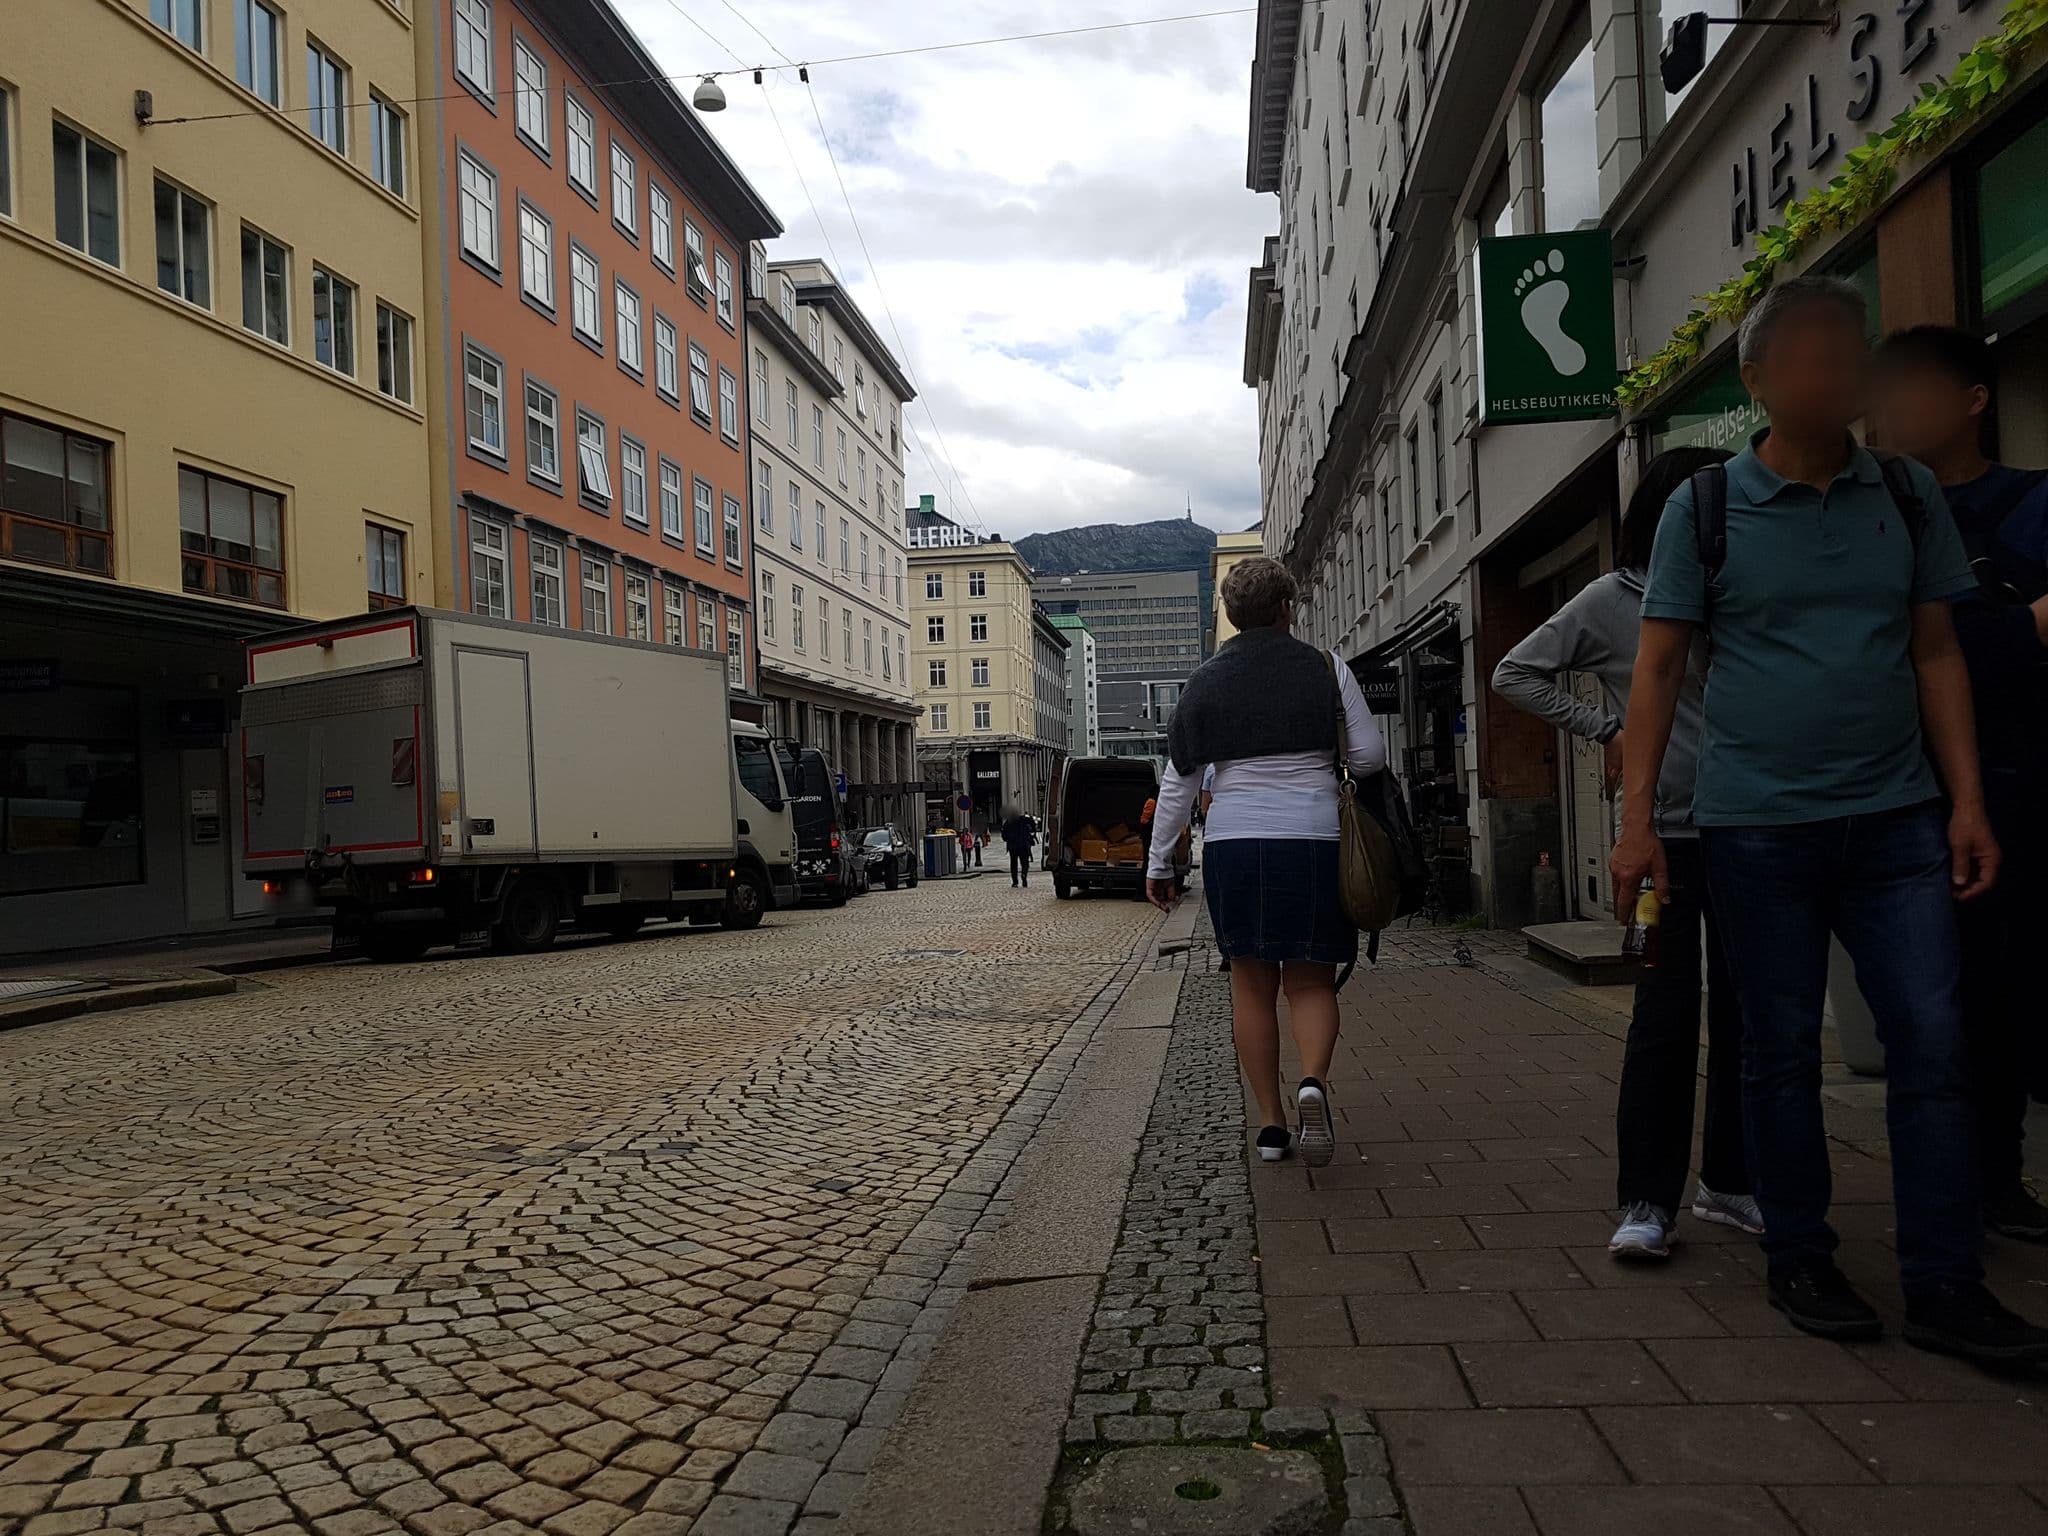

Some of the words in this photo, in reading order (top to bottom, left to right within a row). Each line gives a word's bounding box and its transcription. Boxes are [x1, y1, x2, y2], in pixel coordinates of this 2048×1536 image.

[1731, 0, 1976, 247] HELSE
[1492, 393, 1611, 411] HELSEBUTIKKEN
[1086, 639, 1096, 748] XHIBITION
[1360, 682, 1396, 693] LOMZ
